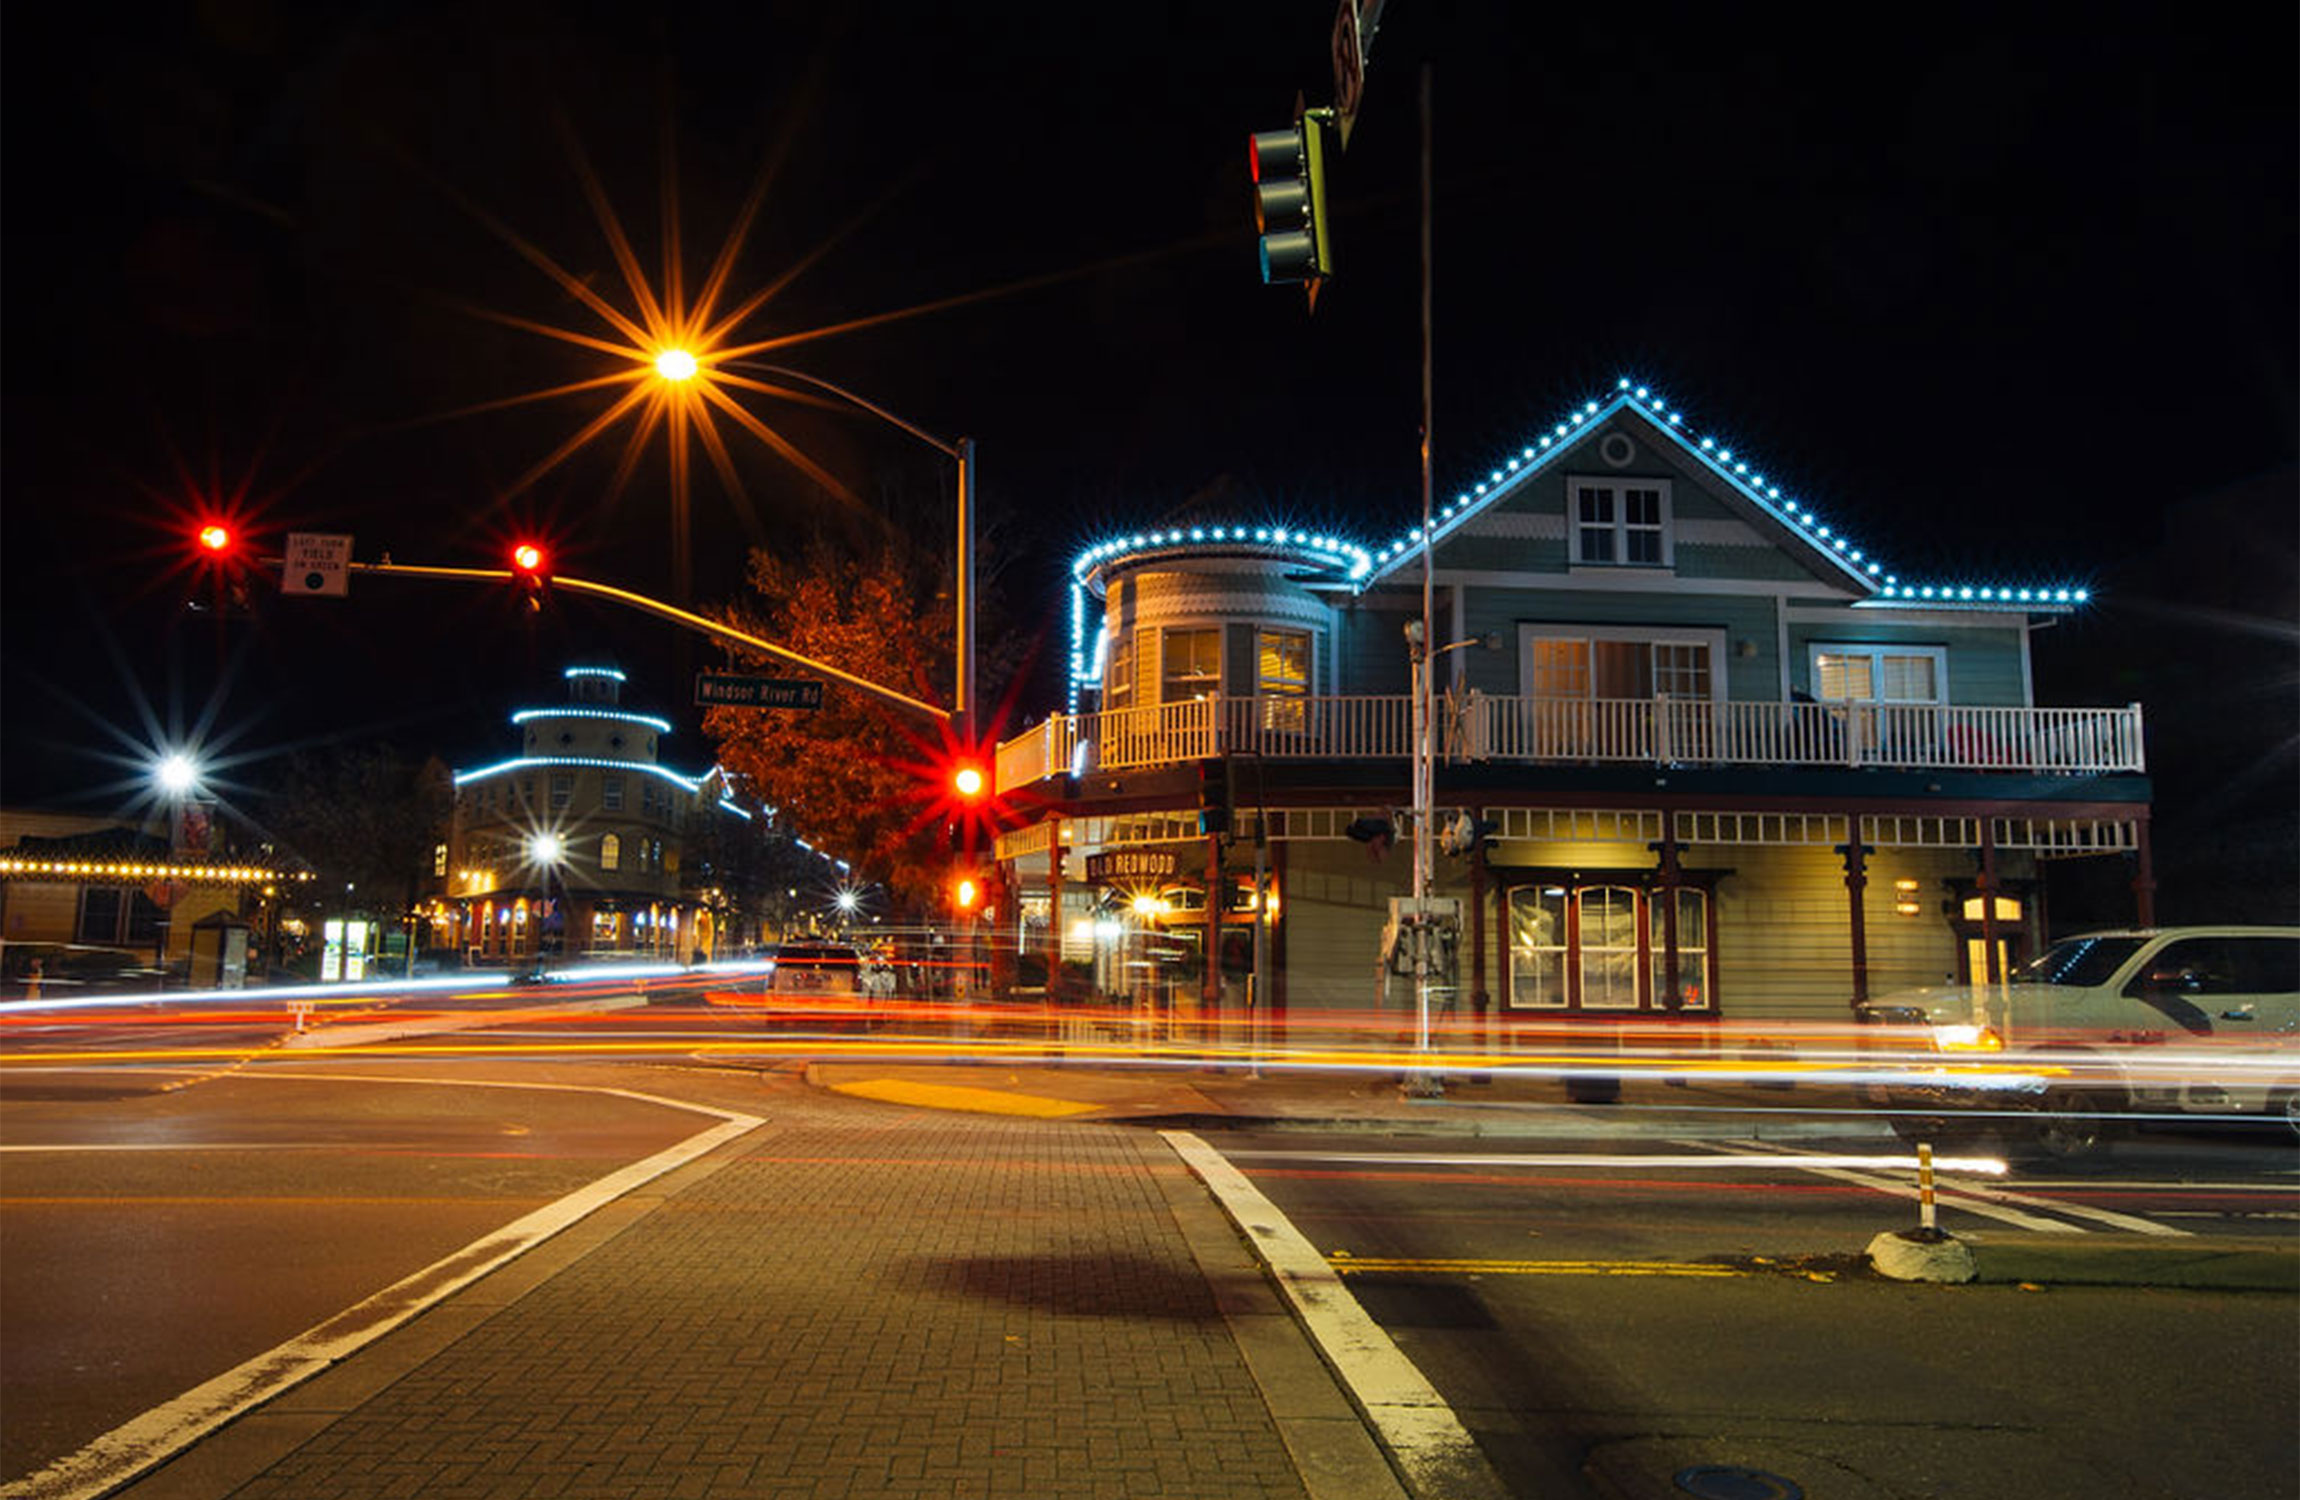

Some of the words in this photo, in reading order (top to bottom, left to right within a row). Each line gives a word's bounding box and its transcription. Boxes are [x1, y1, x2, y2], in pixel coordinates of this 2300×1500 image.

[303, 548, 334, 559] YIELD
[703, 682, 754, 700] Windsor
[761, 684, 796, 702] River
[802, 687, 819, 704] Rd
[1090, 855, 1113, 878] OLD
[1115, 853, 1176, 875] REDWOOD
